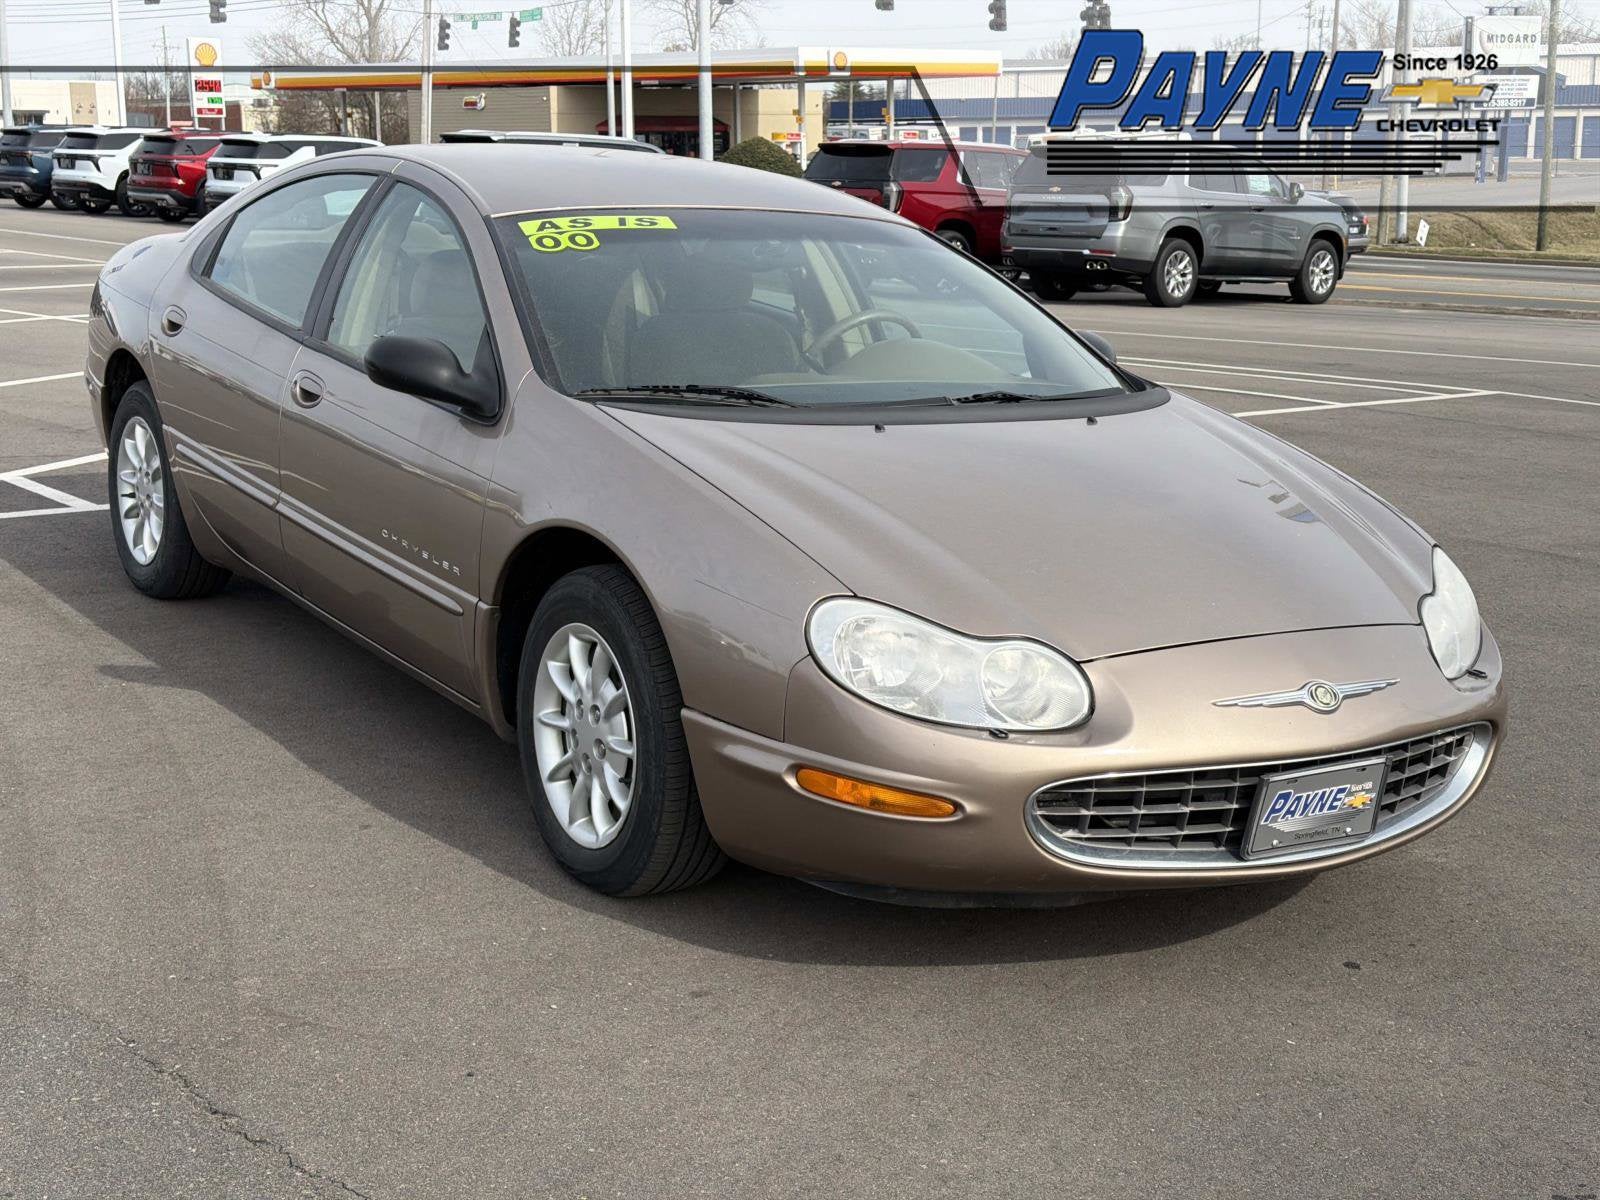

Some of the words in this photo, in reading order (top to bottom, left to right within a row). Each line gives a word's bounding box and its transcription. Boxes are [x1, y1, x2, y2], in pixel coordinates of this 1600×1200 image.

[1486, 33, 1537, 44] MIDGARD
[536, 217, 593, 233] AS
[618, 217, 658, 228] IS
[381, 529, 460, 576] CHRYSLER
[1261, 785, 1350, 825] PAYNE
